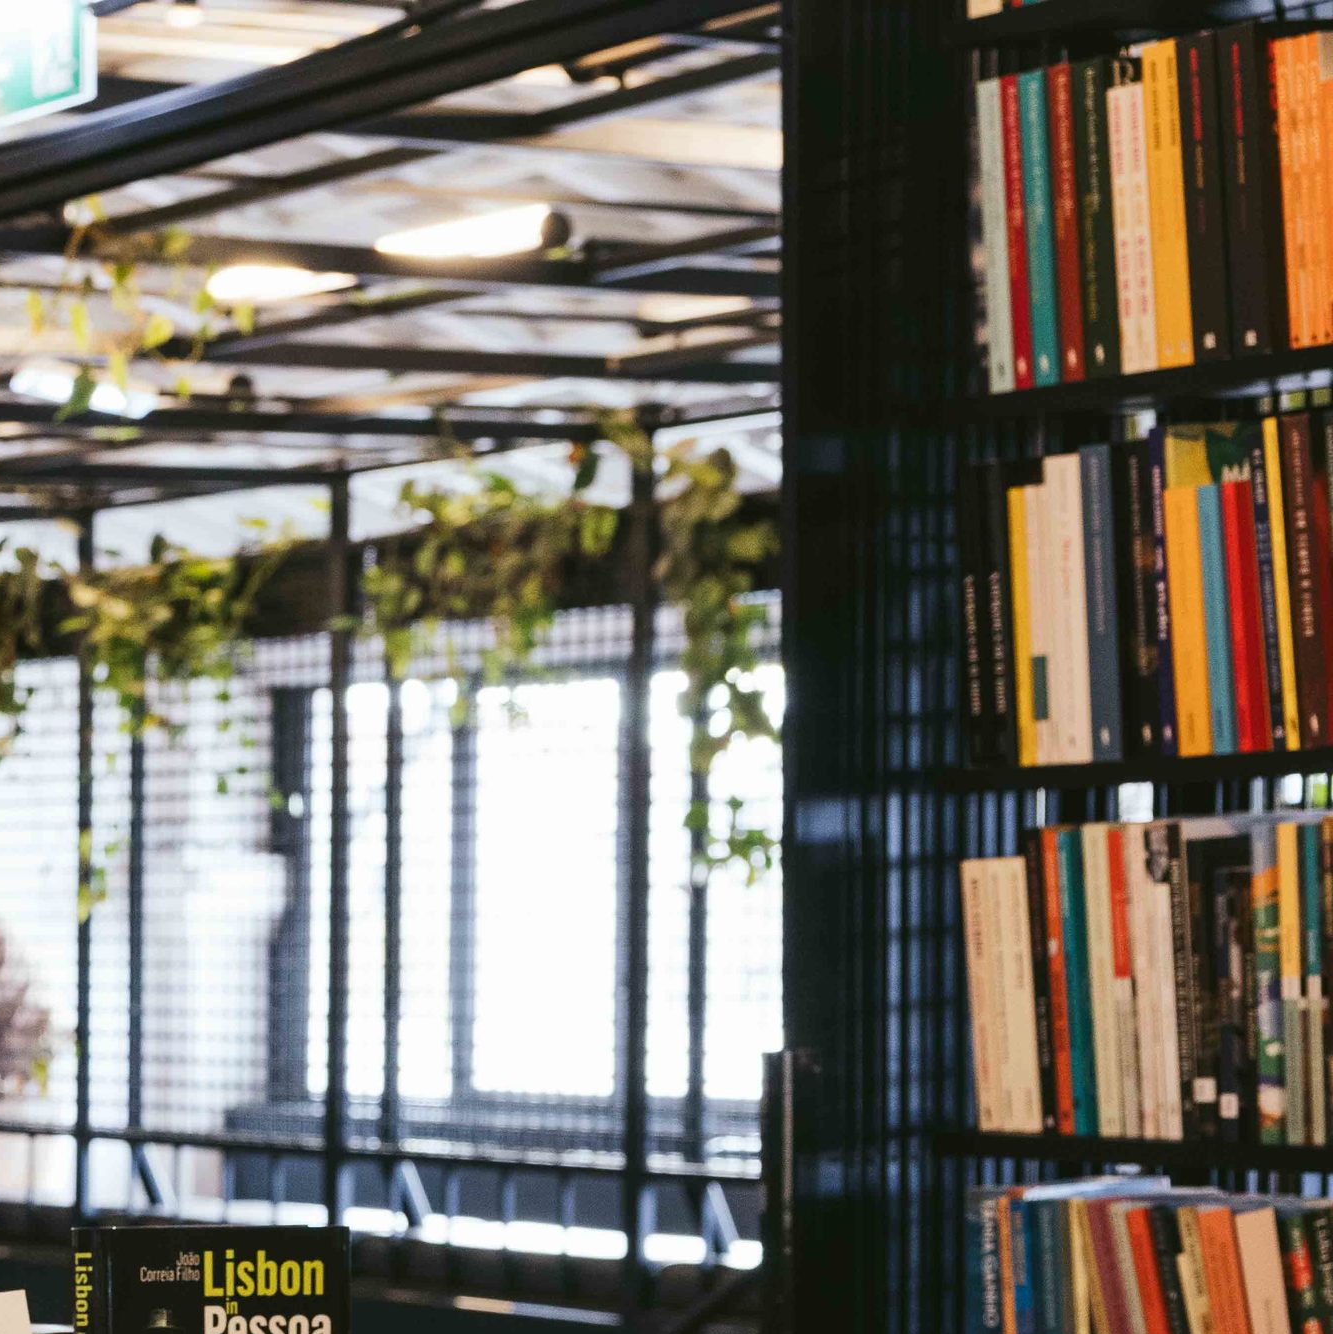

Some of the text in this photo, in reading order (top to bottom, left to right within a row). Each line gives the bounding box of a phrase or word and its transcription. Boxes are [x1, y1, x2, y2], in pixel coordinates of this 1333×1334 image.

[140, 1266, 200, 1282] Correia Filho
[204, 1249, 324, 1297] Lisbon
[75, 1252, 92, 1327] Lisbon
[226, 1299, 238, 1314] in
